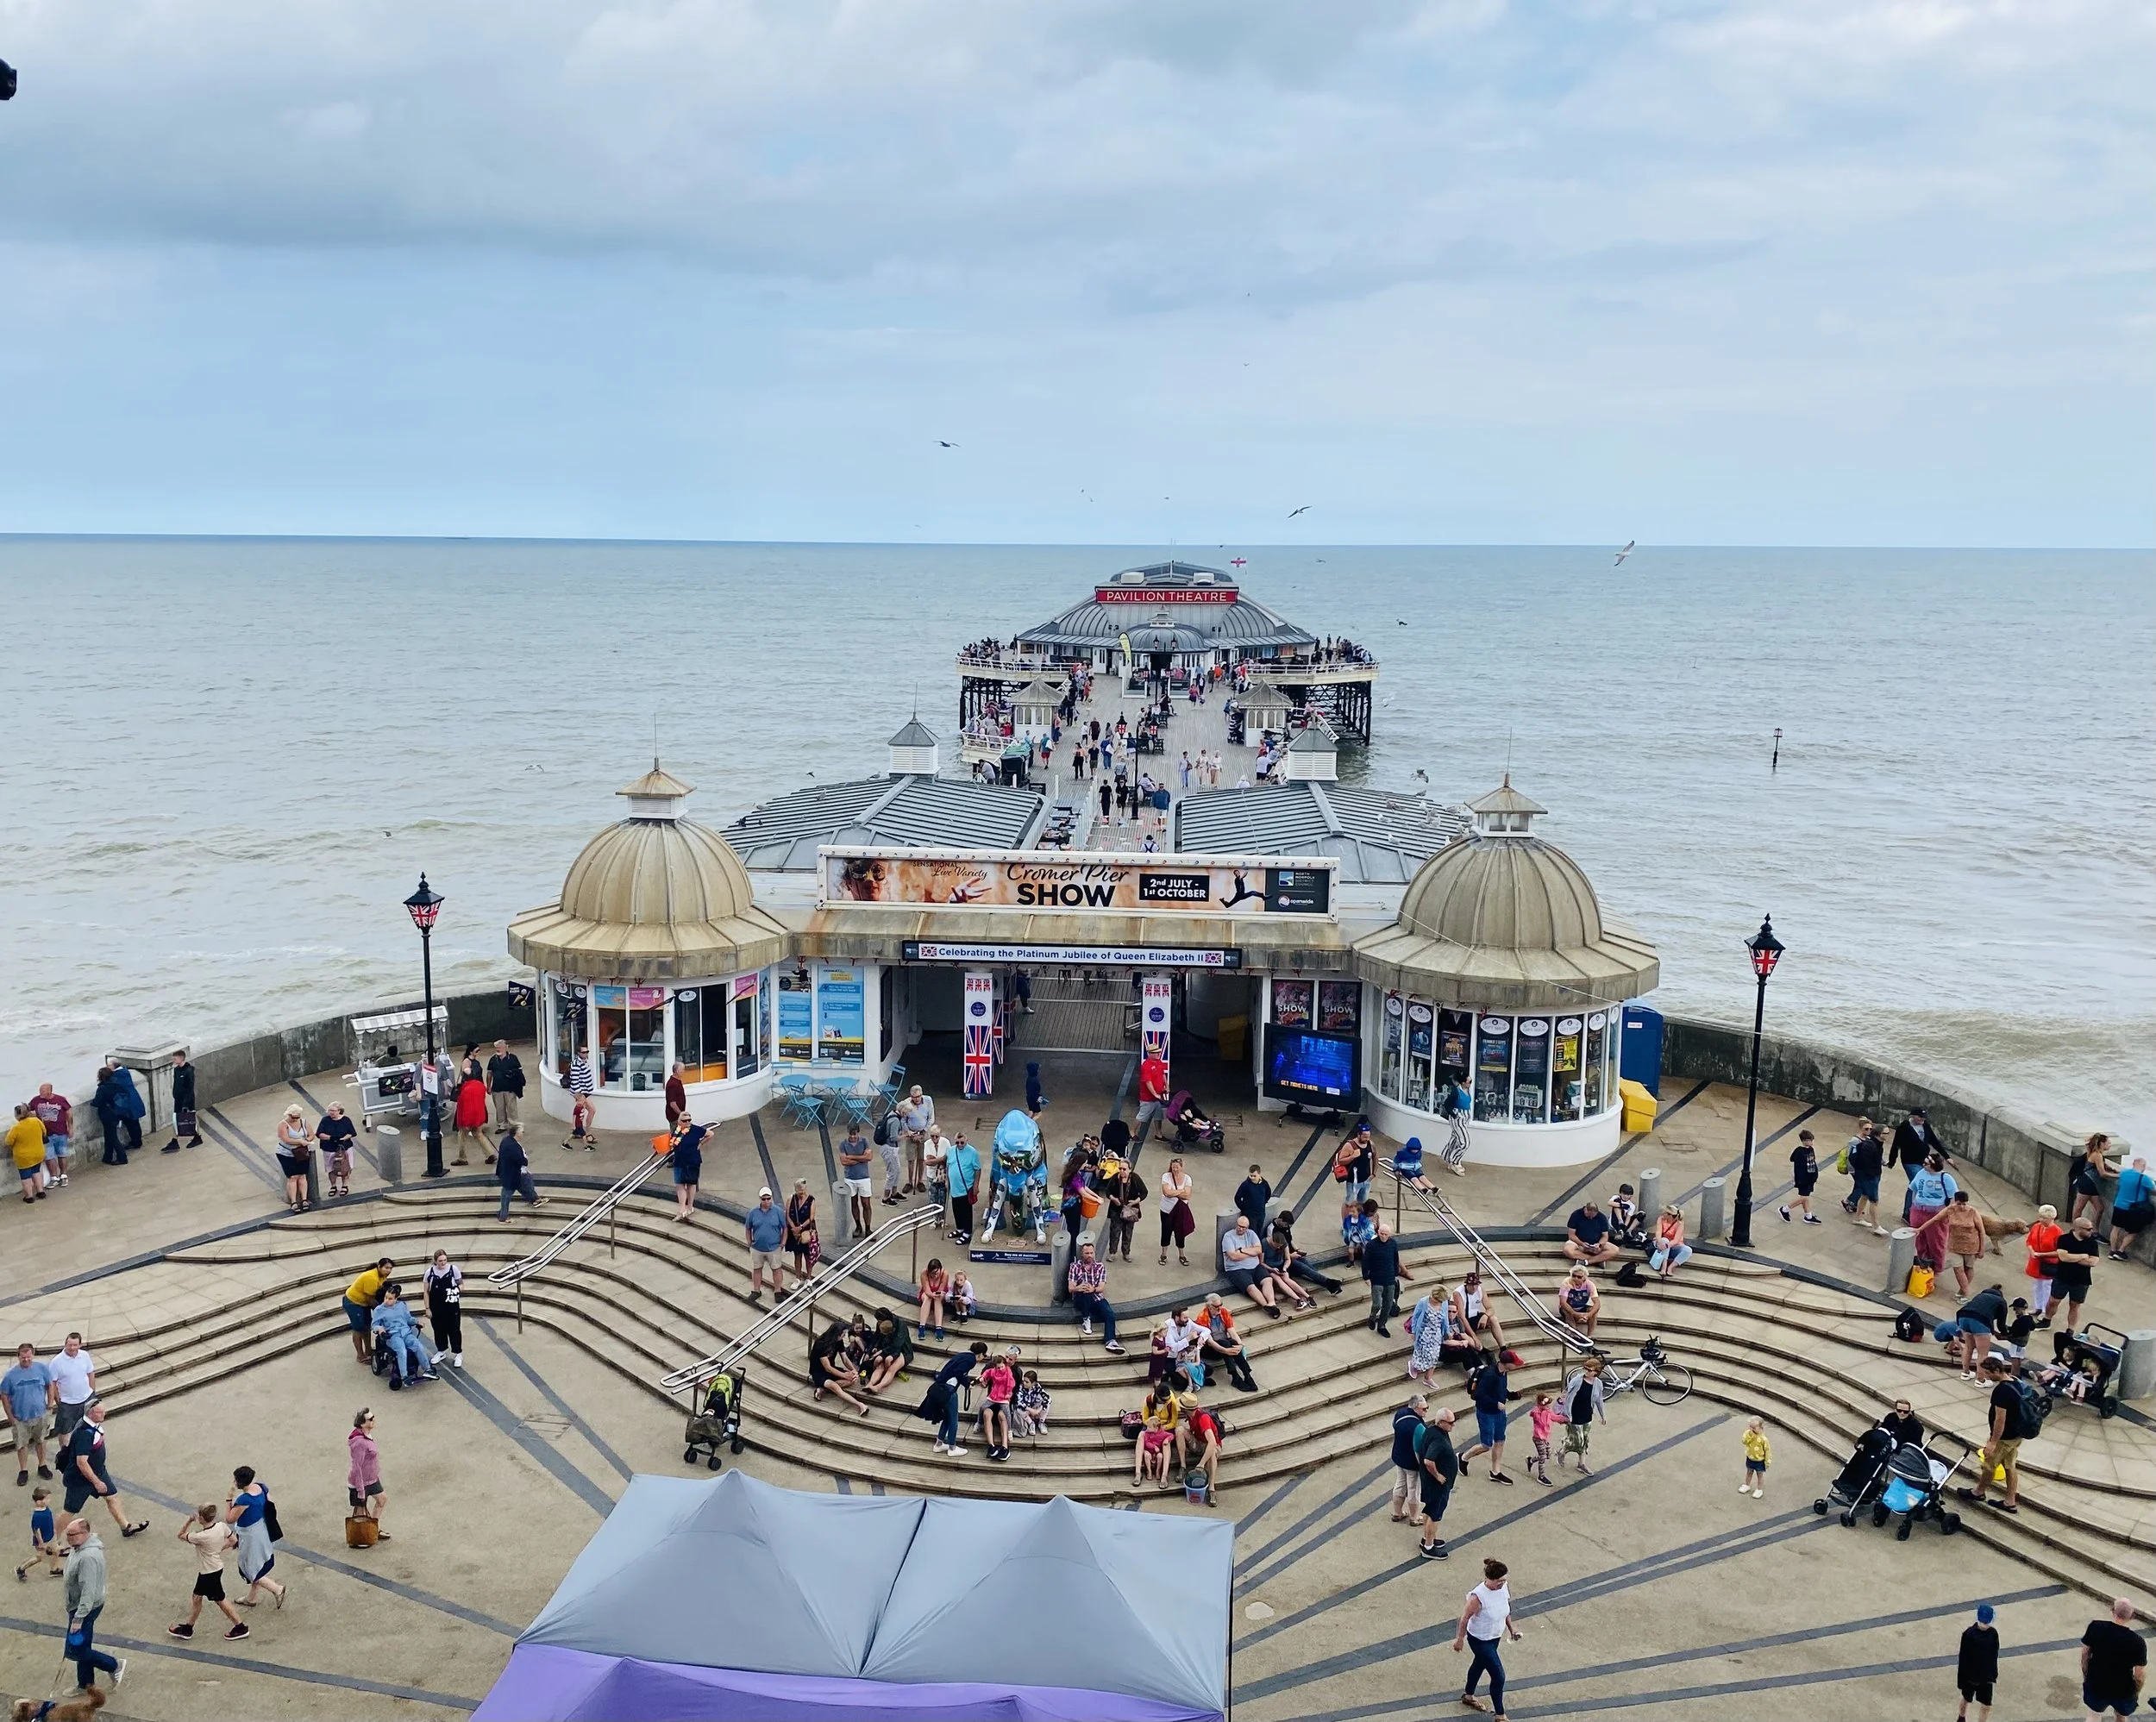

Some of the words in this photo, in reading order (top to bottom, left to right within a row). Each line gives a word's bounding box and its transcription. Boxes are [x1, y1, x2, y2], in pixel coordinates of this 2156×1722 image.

[1106, 592, 1165, 601] PAVILION
[1169, 592, 1227, 602] THEATRE
[912, 861, 959, 869] SENSATIONAL
[931, 867, 952, 877] Live
[955, 866, 988, 880] Variety
[1006, 862, 1079, 881] Cromer
[1080, 864, 1130, 884] Pier
[1150, 879, 1166, 888] 2nd
[1167, 879, 1194, 889] JULY
[1017, 884, 1116, 907] SHOW
[1143, 889, 1156, 898] 1st
[1157, 889, 1206, 899] OCTOBER
[938, 948, 995, 959] Celebrating
[1017, 949, 1059, 958] Platinum
[1062, 950, 1098, 960] Jubilee
[1113, 952, 1146, 961] Queen
[1149, 953, 1194, 961] Elizabeth
[1325, 1005, 1353, 1014] SHOW
